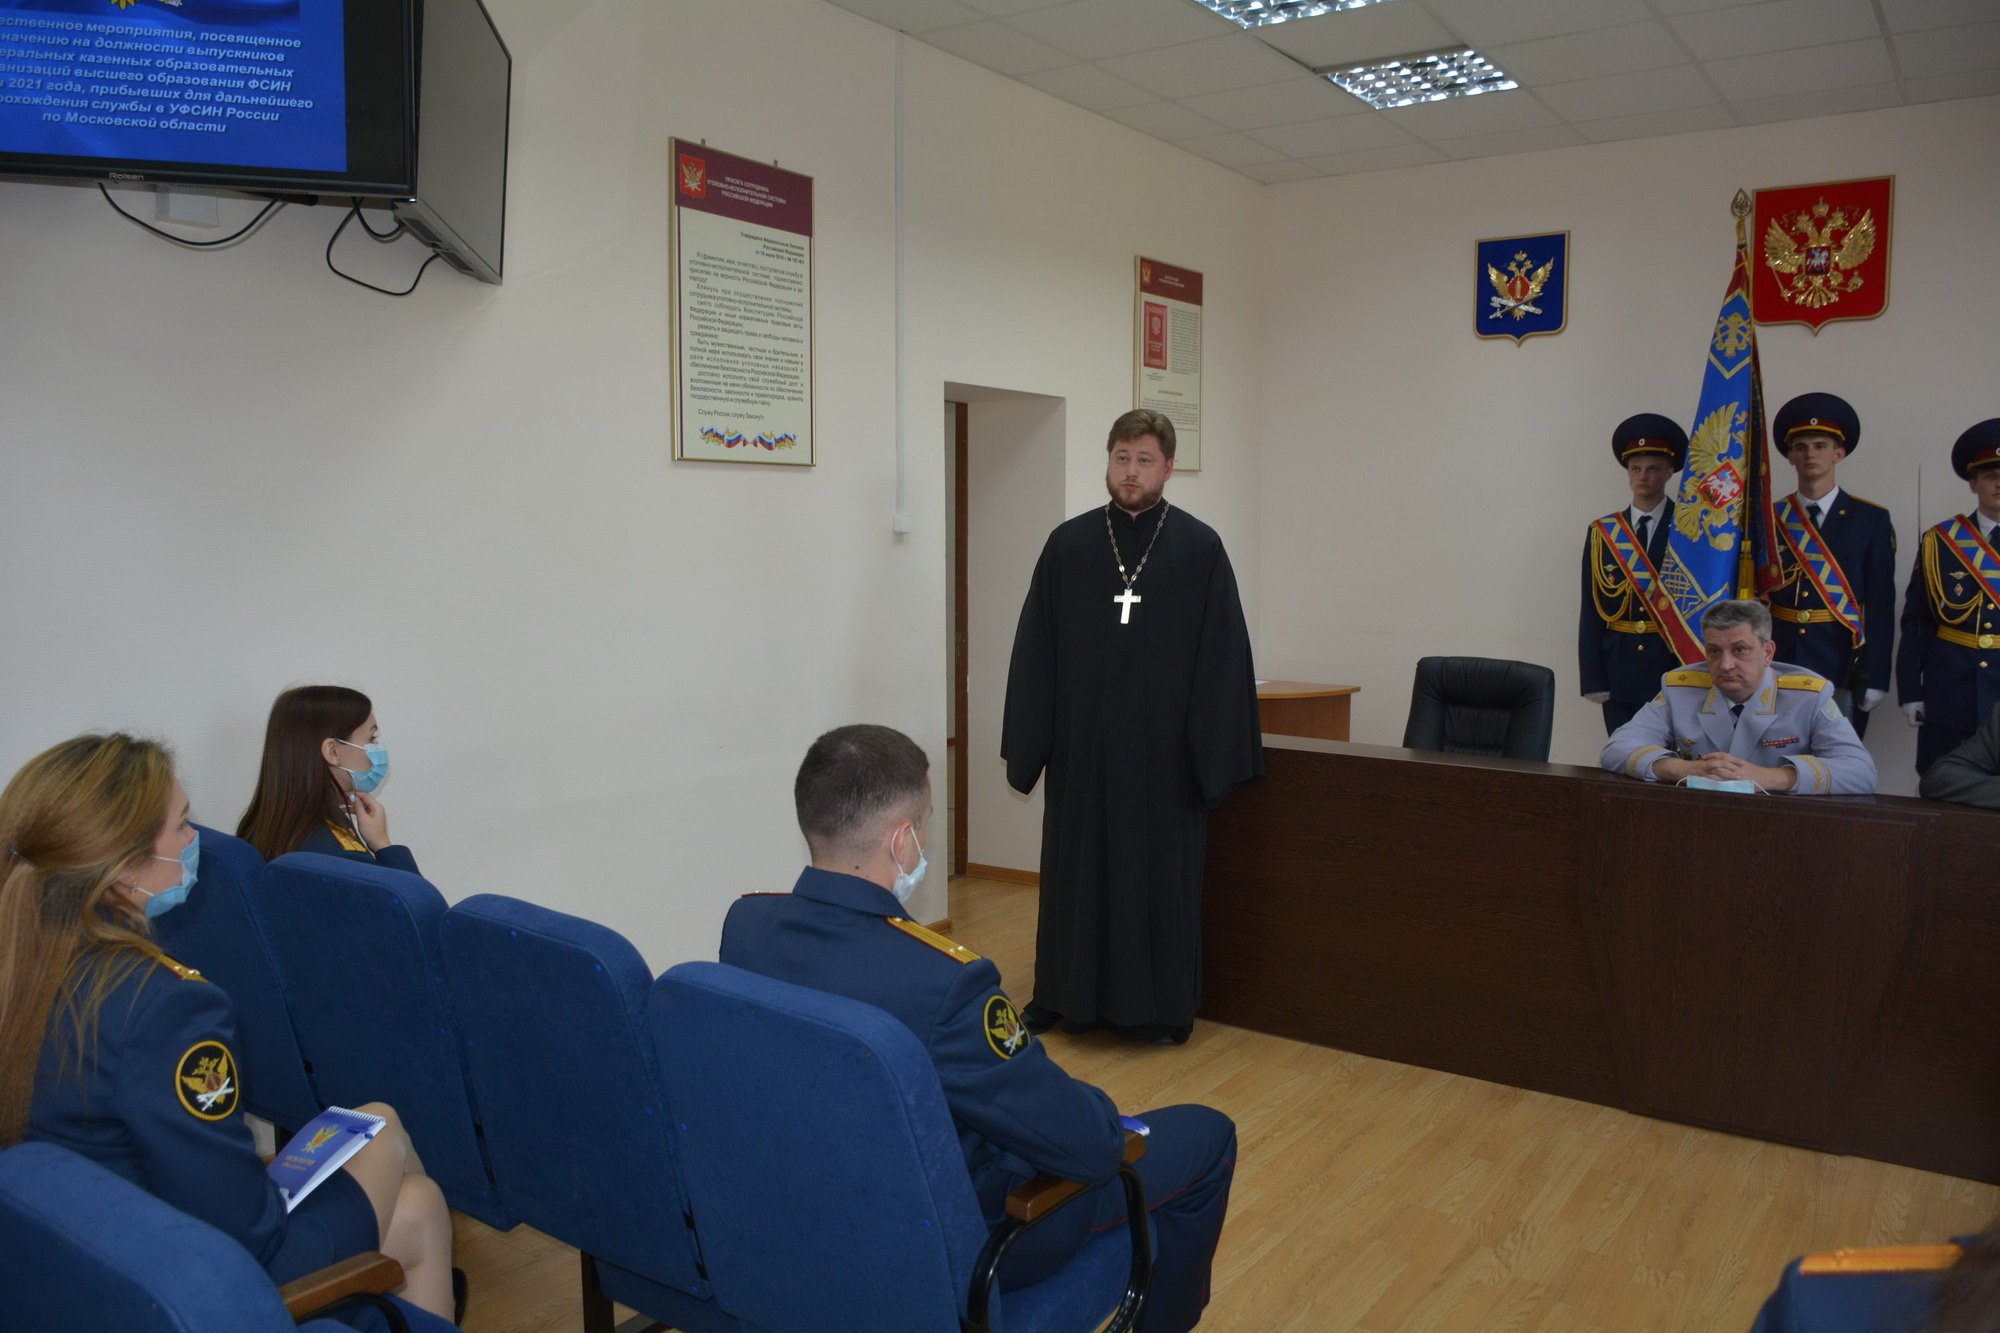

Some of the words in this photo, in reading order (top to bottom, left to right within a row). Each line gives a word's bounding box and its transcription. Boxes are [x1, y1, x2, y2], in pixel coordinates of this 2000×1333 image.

[87, 23, 196, 41] мероприятия,
[200, 32, 301, 48] посвященное
[73, 39, 90, 47] на
[94, 37, 183, 54] должности
[187, 46, 285, 62] выпускников
[79, 53, 152, 67] казенных
[155, 58, 294, 78] образовательных
[74, 68, 144, 81] высшего
[147, 72, 245, 89] образования
[248, 79, 291, 92] ФСИН
[8, 78, 42, 89] 2021
[46, 81, 86, 94] года,
[90, 84, 181, 99] прибывших
[184, 89, 211, 101] для
[215, 91, 314, 109] дальнейшего
[42, 112, 61, 123] по
[65, 112, 157, 128] Московской
[160, 119, 226, 133] области
[91, 100, 152, 113] службы
[155, 104, 165, 113] в
[169, 103, 222, 117] УФСИН
[226, 107, 279, 121] России
